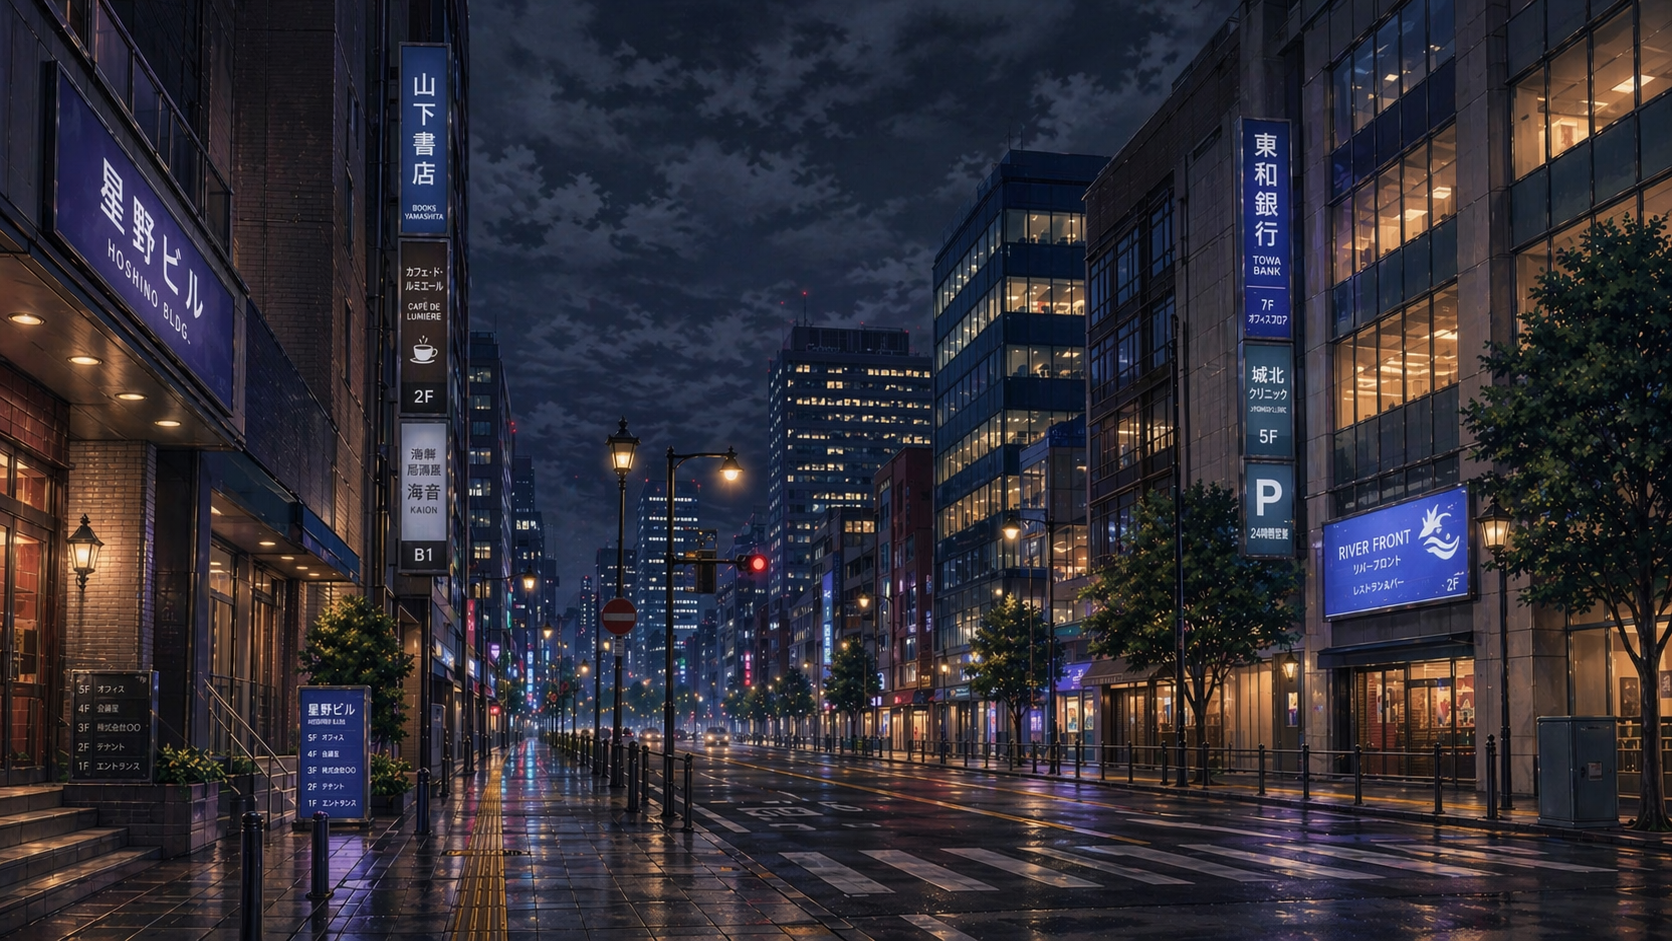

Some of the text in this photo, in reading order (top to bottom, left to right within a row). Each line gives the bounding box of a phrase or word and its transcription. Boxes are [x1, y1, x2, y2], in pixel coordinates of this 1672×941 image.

[413, 73, 436, 185] 山下書店
[1255, 133, 1278, 246] 東和銀行
[412, 204, 437, 213] BOOKS
[404, 212, 444, 220] YAMASHITA
[101, 157, 203, 319] 星野ビル
[1253, 255, 1282, 266] TOWA
[1253, 265, 1281, 276] BANK
[108, 238, 190, 345] HOSHINO BLDG.
[405, 282, 444, 292] ルミエール
[429, 302, 441, 311] DE
[1262, 299, 1273, 310] 7F
[1252, 366, 1284, 383] 城北
[415, 390, 434, 403] 2F
[1250, 388, 1287, 400] クリニック
[1260, 429, 1277, 443] 5F
[408, 483, 441, 500] 海音
[1257, 479, 1282, 516] P
[411, 506, 438, 514] KAION
[1338, 529, 1412, 561] RIVER FRONT
[415, 548, 432, 561] B1
[1353, 555, 1402, 575] リバーフロント
[1446, 577, 1459, 592] 2F
[78, 684, 125, 695] 5F オフィス
[78, 704, 90, 713] 4F
[307, 702, 356, 717] 星野ビル
[77, 722, 90, 733] 3F
[77, 742, 90, 752] 2F
[307, 750, 317, 758] 4F
[78, 761, 89, 771] 1F
[307, 766, 318, 775] 3F
[307, 782, 318, 791] 2F
[308, 799, 317, 807] 1F
